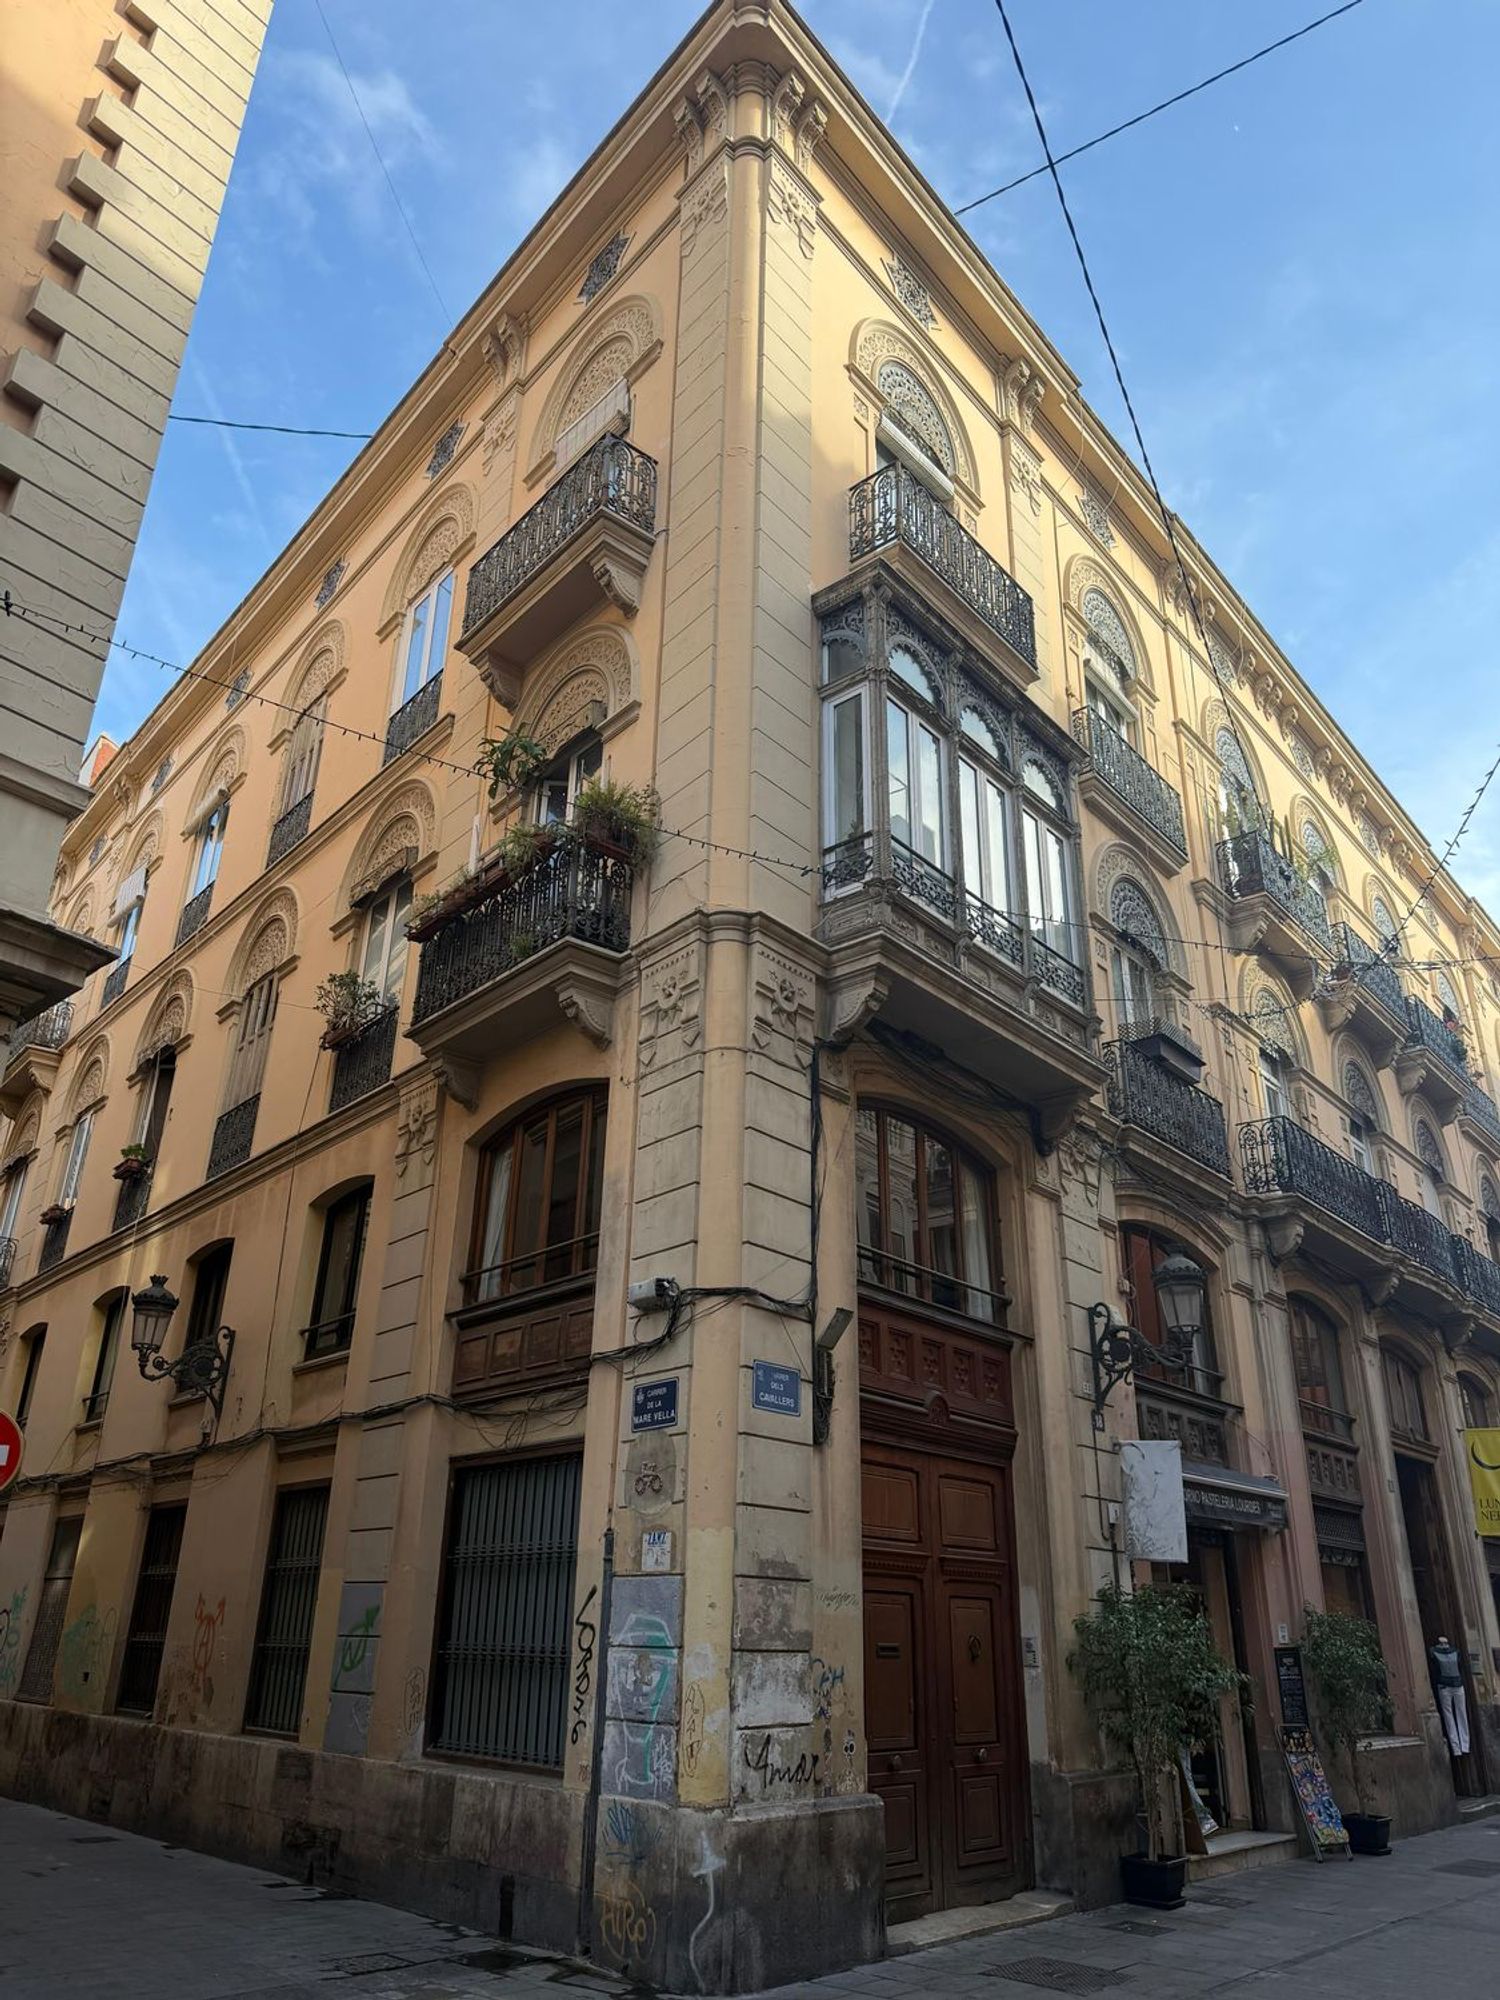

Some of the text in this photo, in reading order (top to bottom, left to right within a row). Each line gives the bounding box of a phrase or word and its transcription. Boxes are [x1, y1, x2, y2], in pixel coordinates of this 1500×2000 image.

[646, 1400, 662, 1409] DE LA
[759, 1391, 795, 1408] CAVALLERS
[653, 1409, 675, 1420] VELLA
